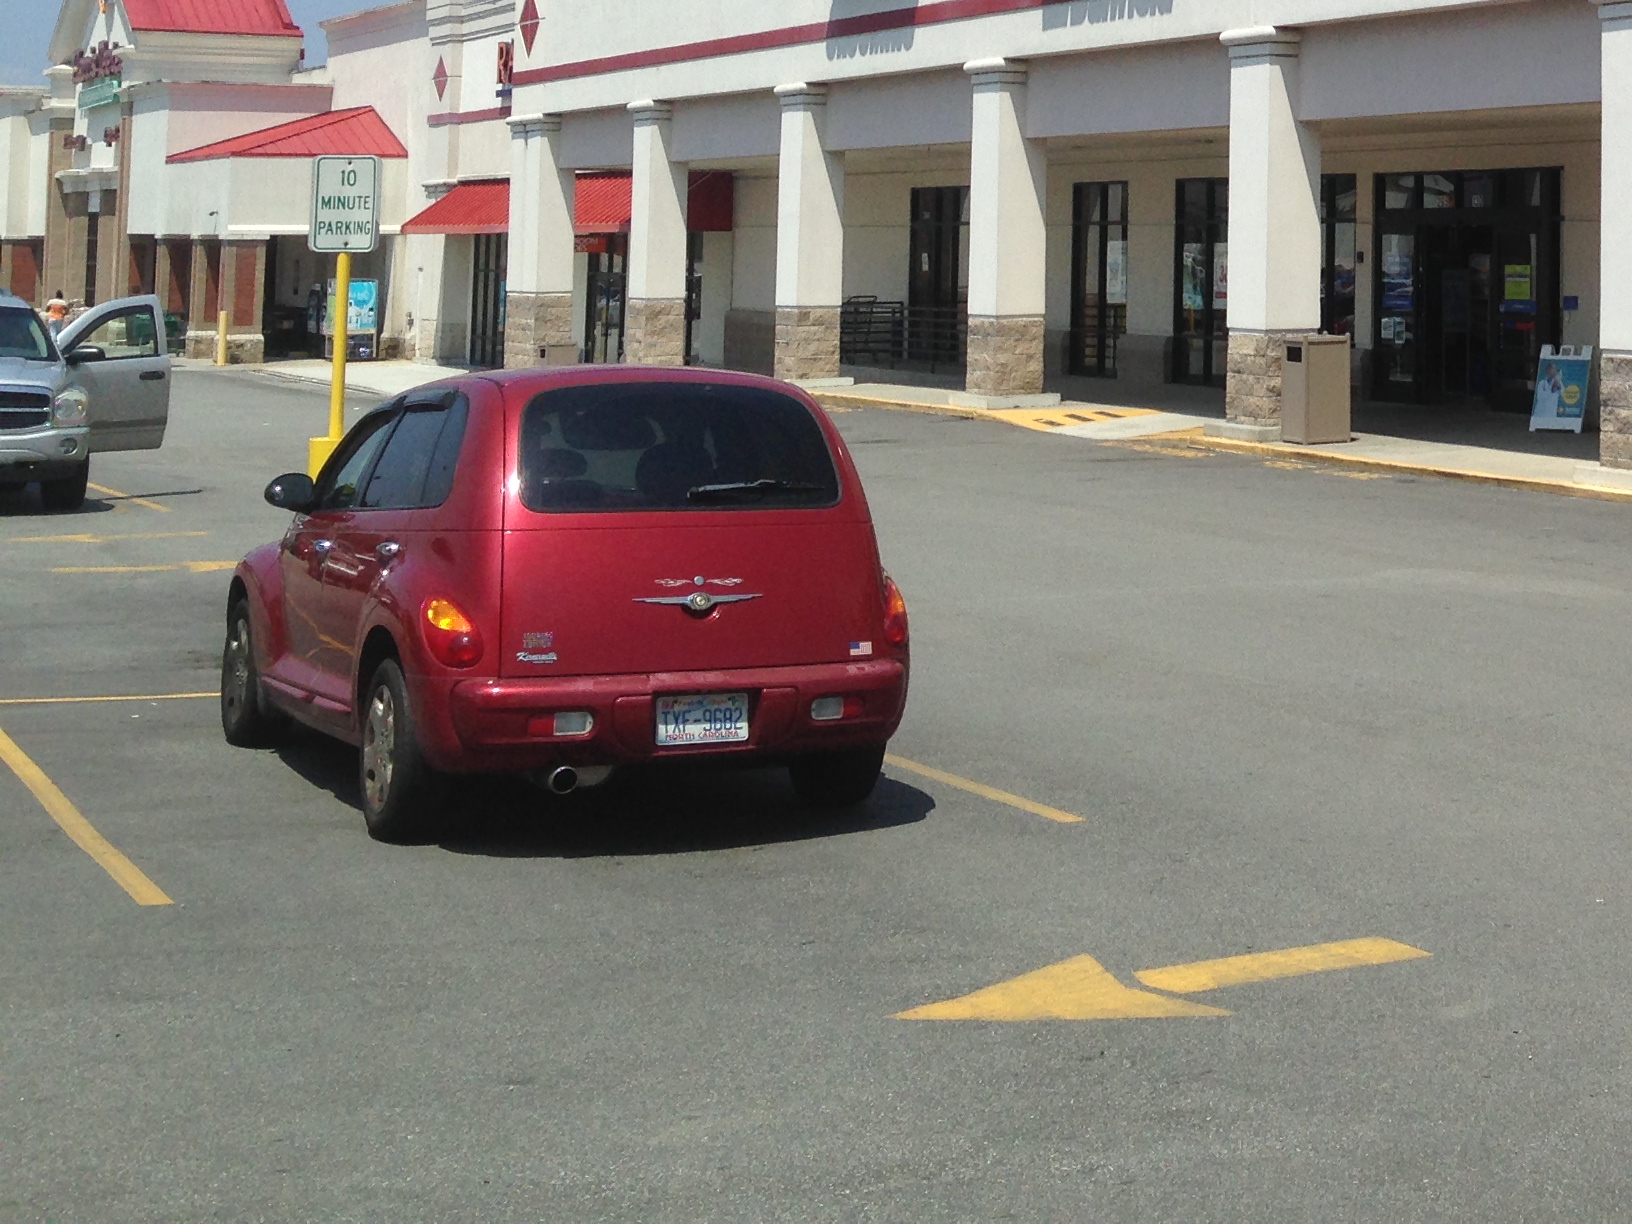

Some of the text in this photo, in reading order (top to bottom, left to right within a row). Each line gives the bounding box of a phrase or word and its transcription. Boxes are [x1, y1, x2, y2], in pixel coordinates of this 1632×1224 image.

[341, 169, 357, 187] 10
[320, 196, 371, 210] MINUTE
[317, 221, 371, 236] PARKING
[661, 707, 744, 733] TXF-9682
[665, 729, 739, 741] NORTH CAROLINA
